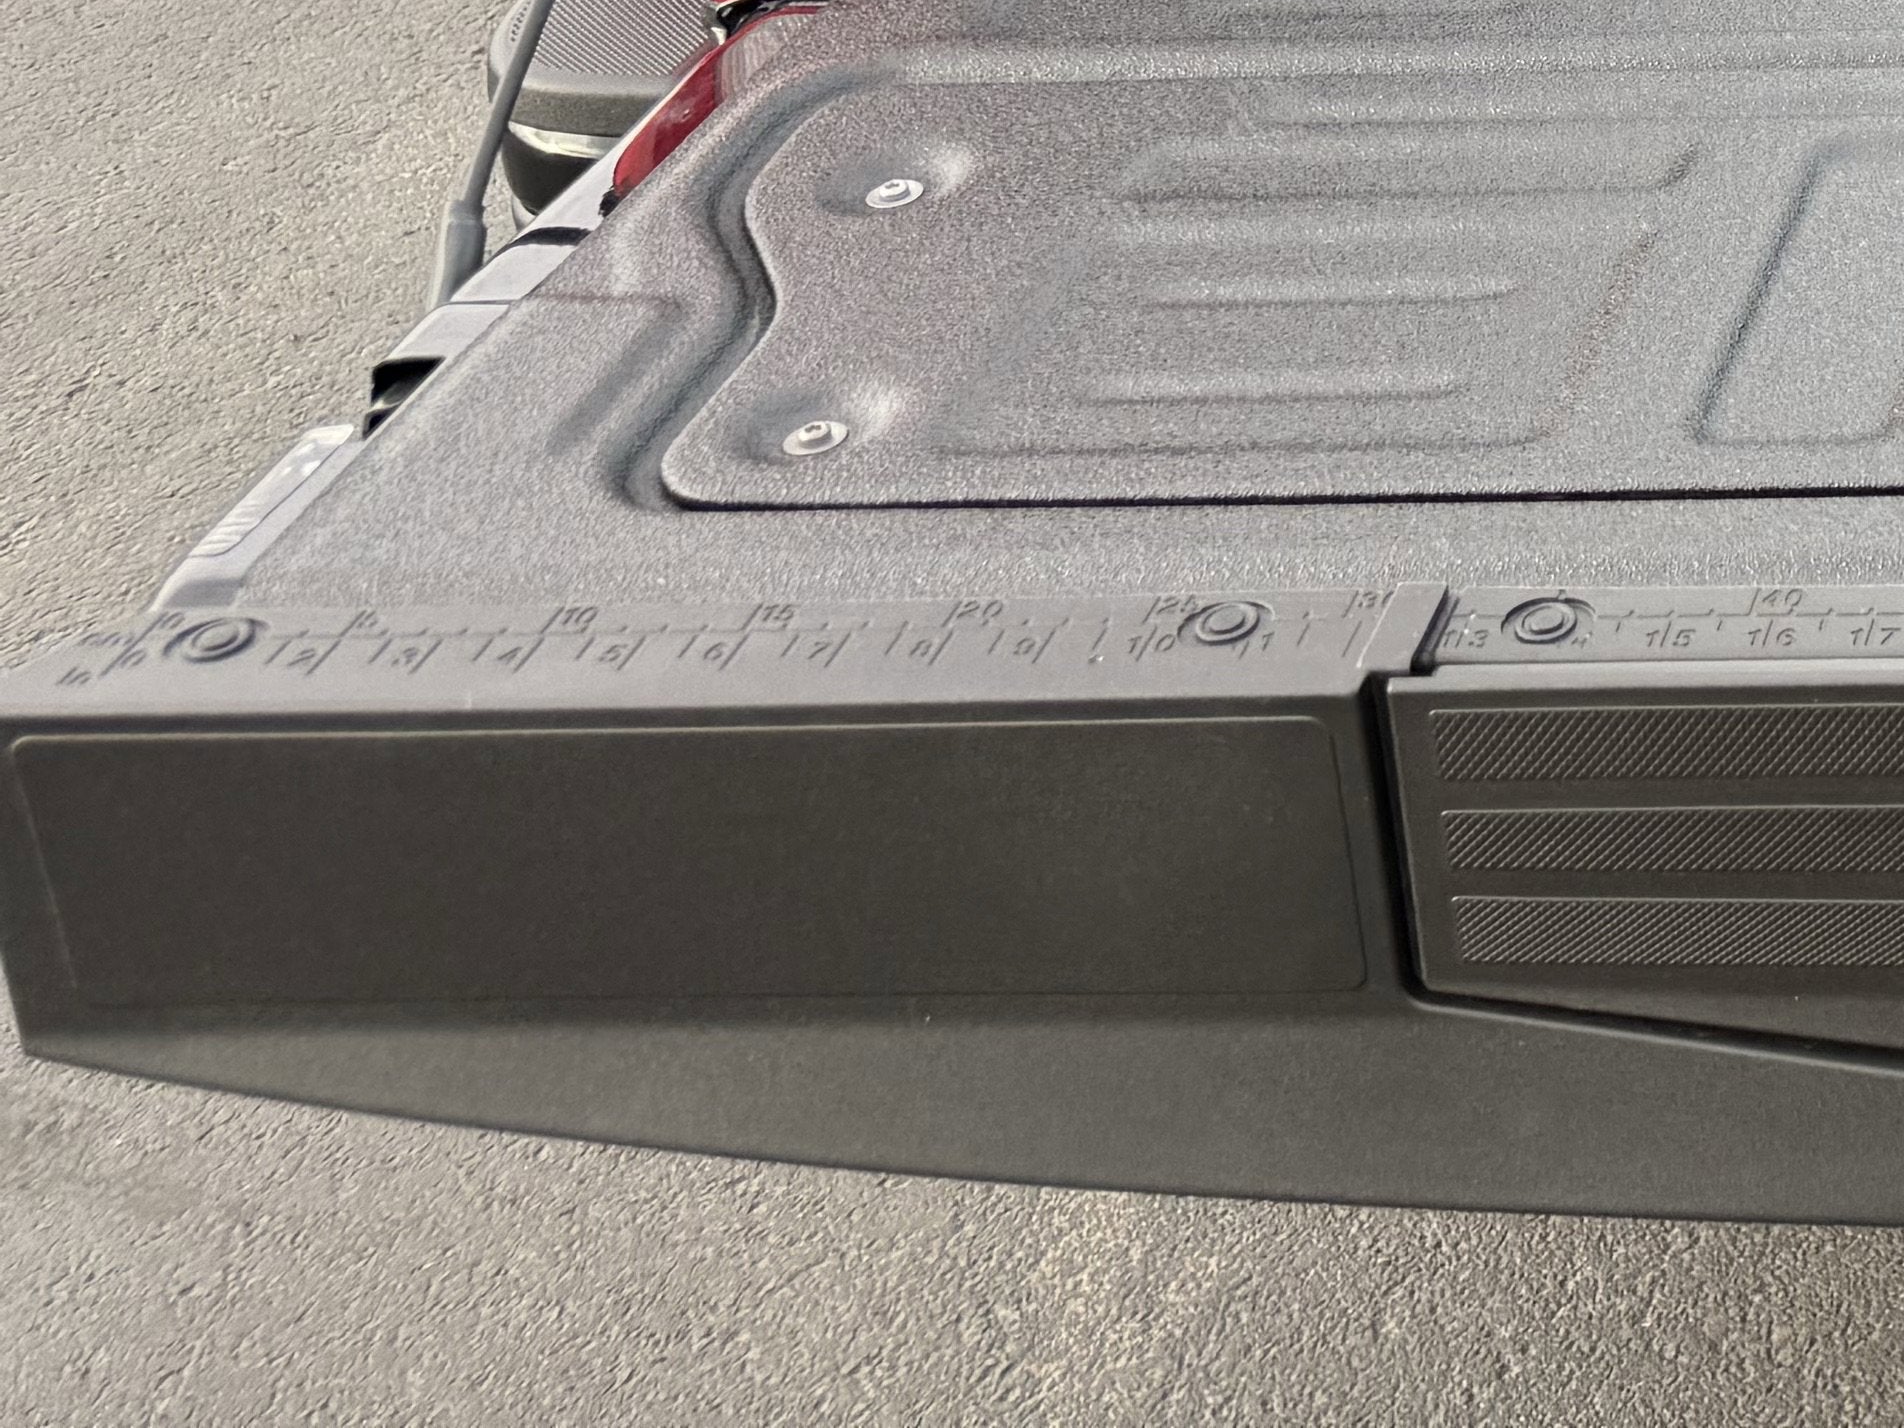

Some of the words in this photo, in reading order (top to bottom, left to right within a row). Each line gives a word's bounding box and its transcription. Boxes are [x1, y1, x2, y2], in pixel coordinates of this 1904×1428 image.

[761, 603, 796, 624] 15
[956, 598, 1004, 620] 20
[1761, 587, 1804, 608] 40
[1645, 628, 1698, 649] 15
[1747, 628, 1798, 648] 16
[1849, 626, 1902, 646] 17
